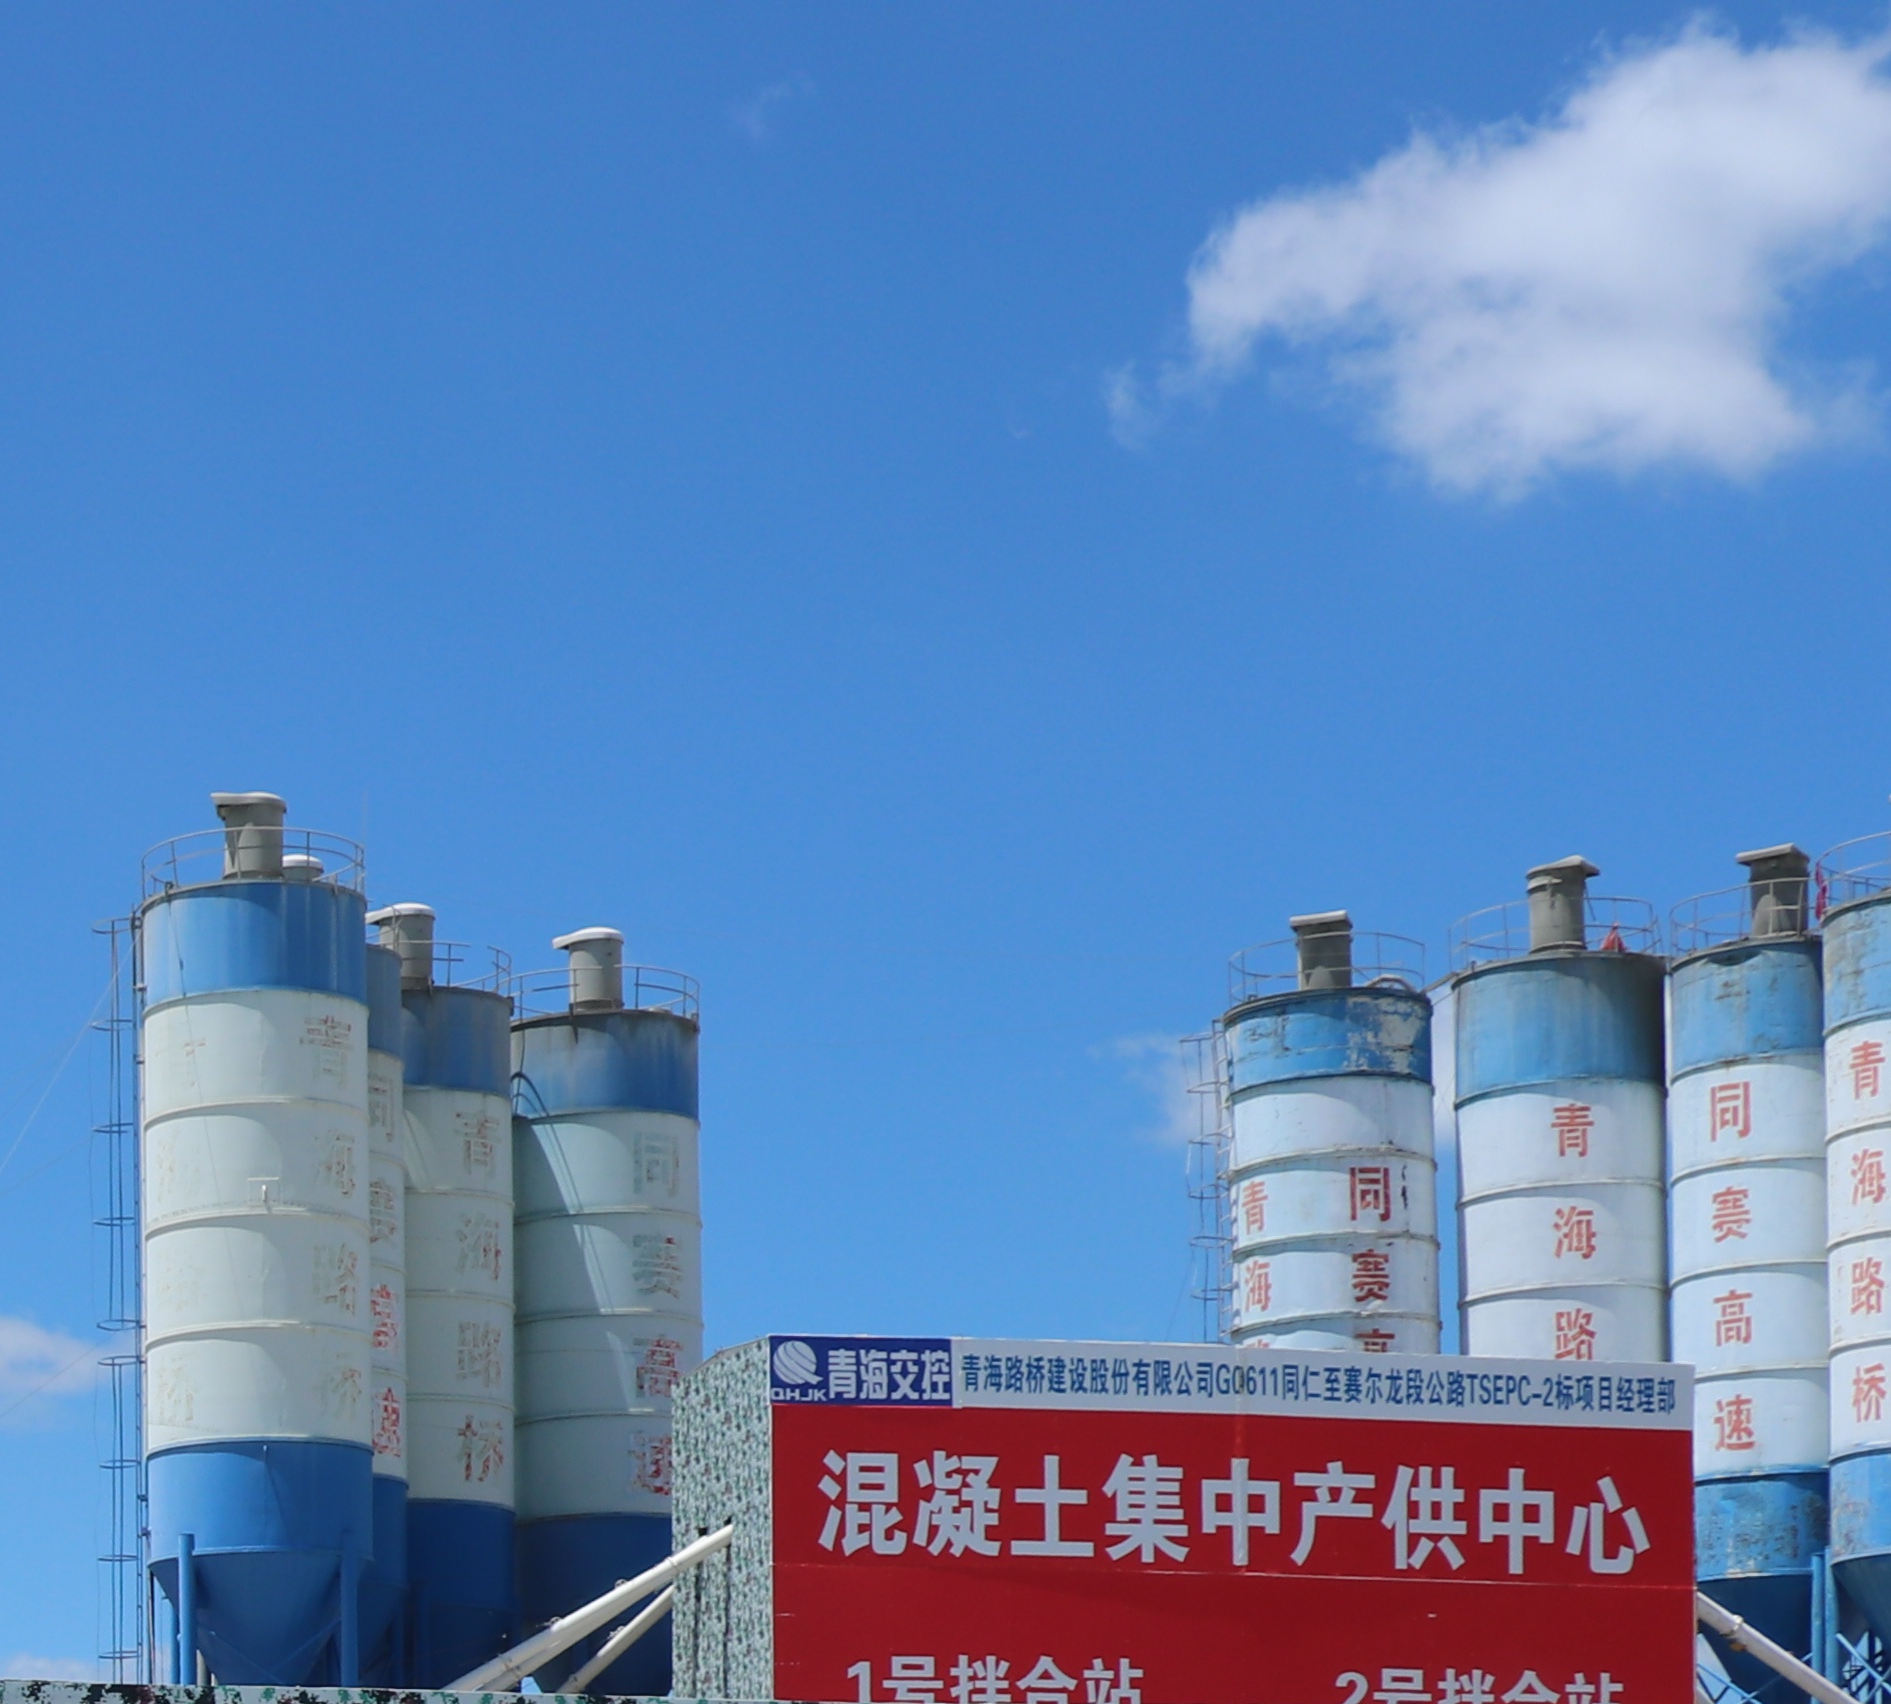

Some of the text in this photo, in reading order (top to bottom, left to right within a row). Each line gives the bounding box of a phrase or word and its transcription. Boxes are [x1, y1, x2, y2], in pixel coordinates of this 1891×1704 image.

[1708, 1079, 1759, 1452] 同赛高速
[1847, 1040, 1889, 1424] 青海路桥
[828, 1349, 951, 1401] 青海交控
[818, 1450, 1652, 1577] 混凝土集中产供中心
